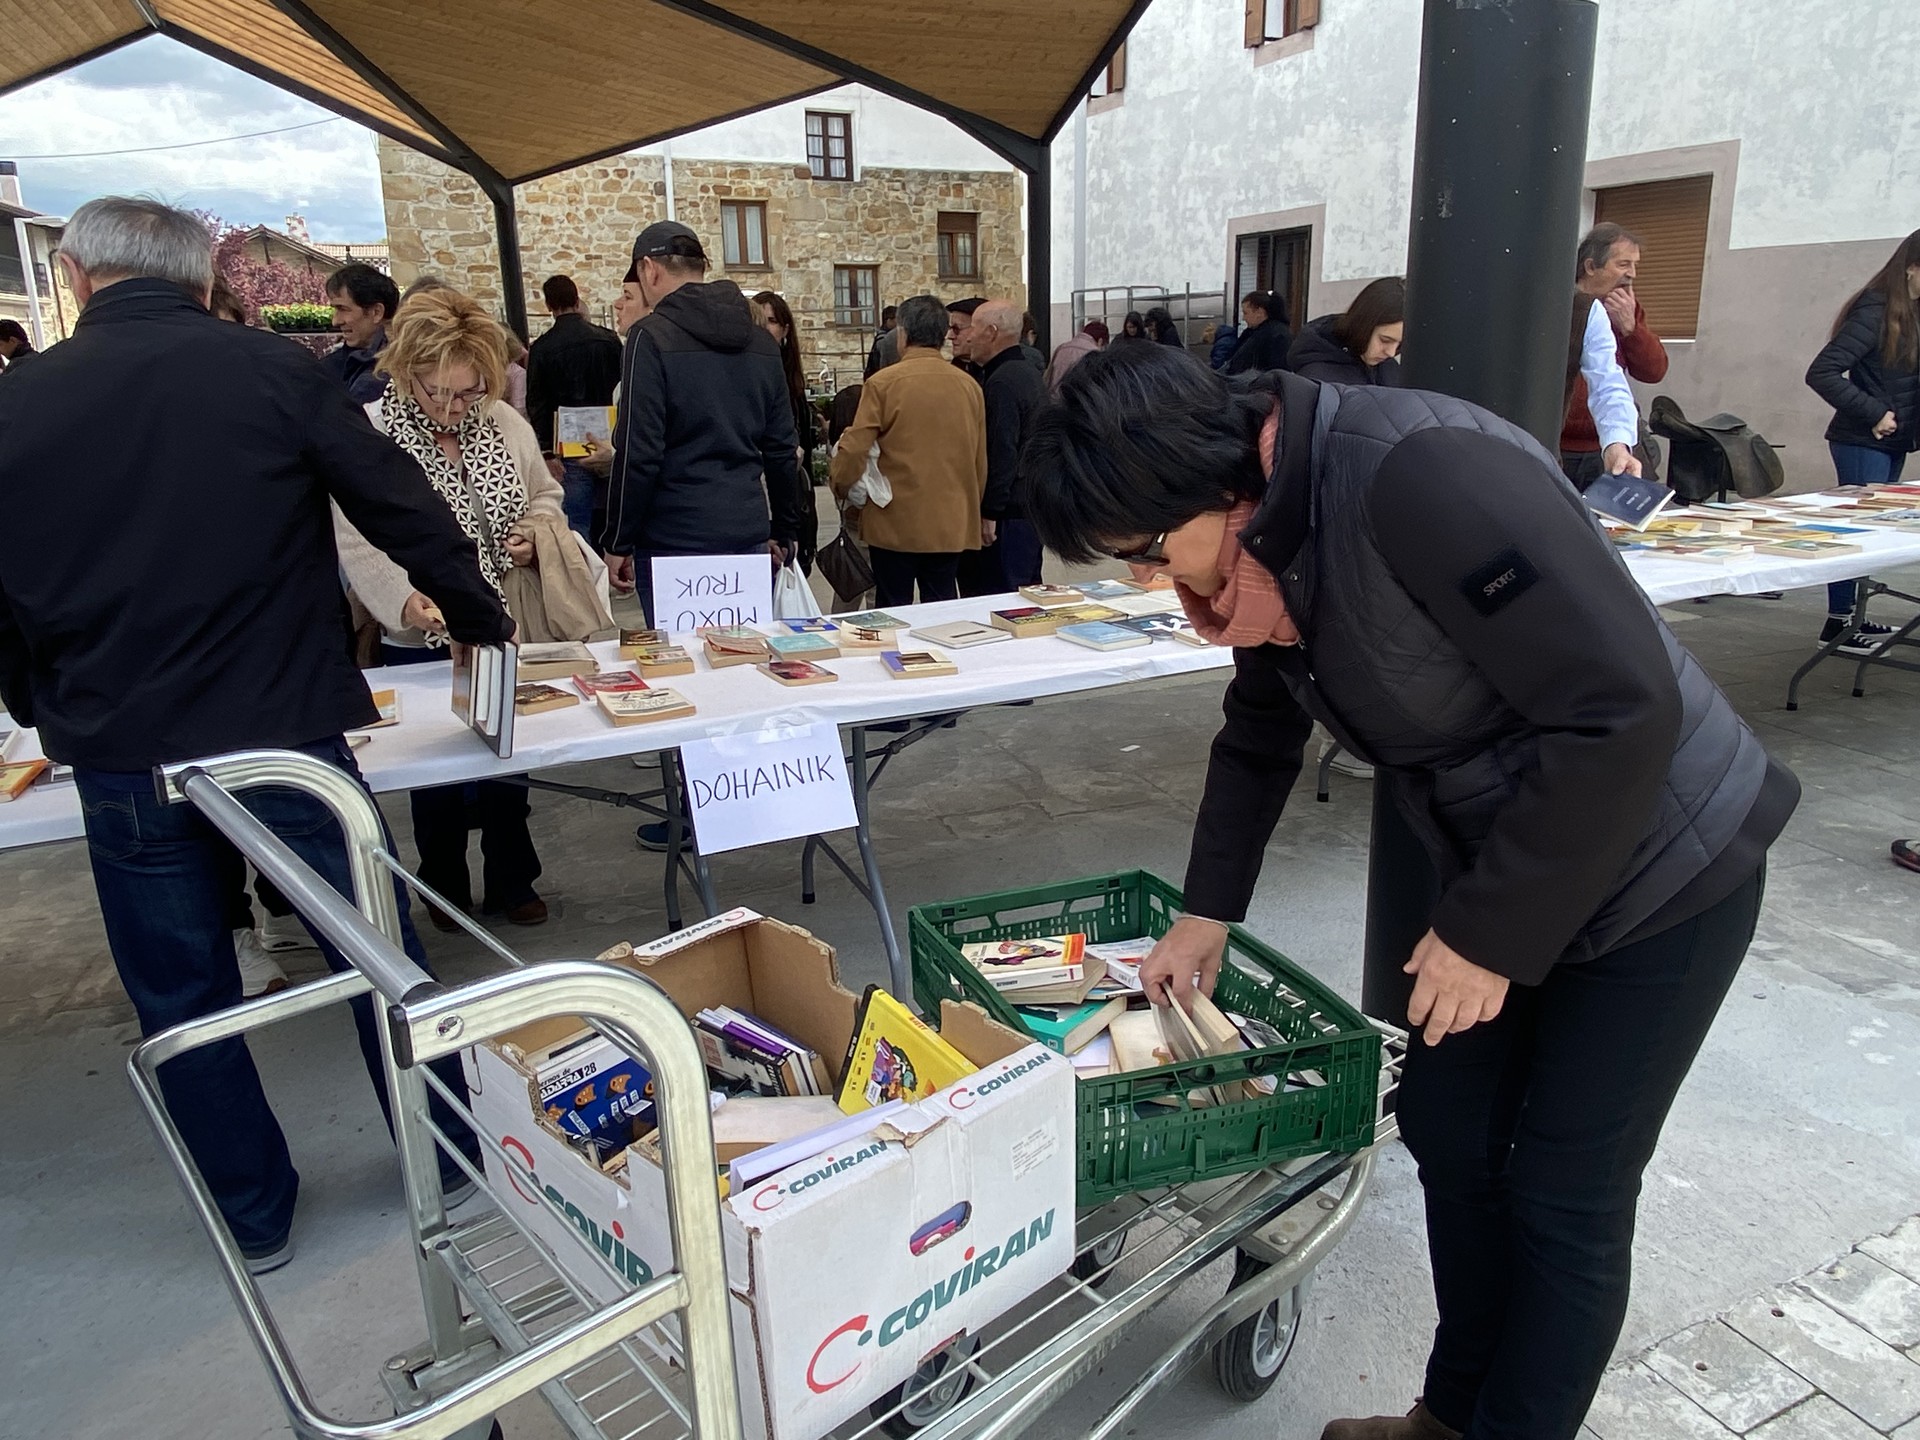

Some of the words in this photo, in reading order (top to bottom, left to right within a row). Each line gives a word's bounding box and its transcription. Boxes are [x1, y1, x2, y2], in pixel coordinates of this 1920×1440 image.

[675, 572, 744, 599] TRUK
[1483, 568, 1516, 596] SPORT
[692, 755, 835, 809] DOHAINIK
[584, 1062, 597, 1077] 28
[977, 1052, 1052, 1096] COVIRAN
[789, 1140, 888, 1194] COVIRAN
[878, 1208, 1055, 1348] COVIRAN
